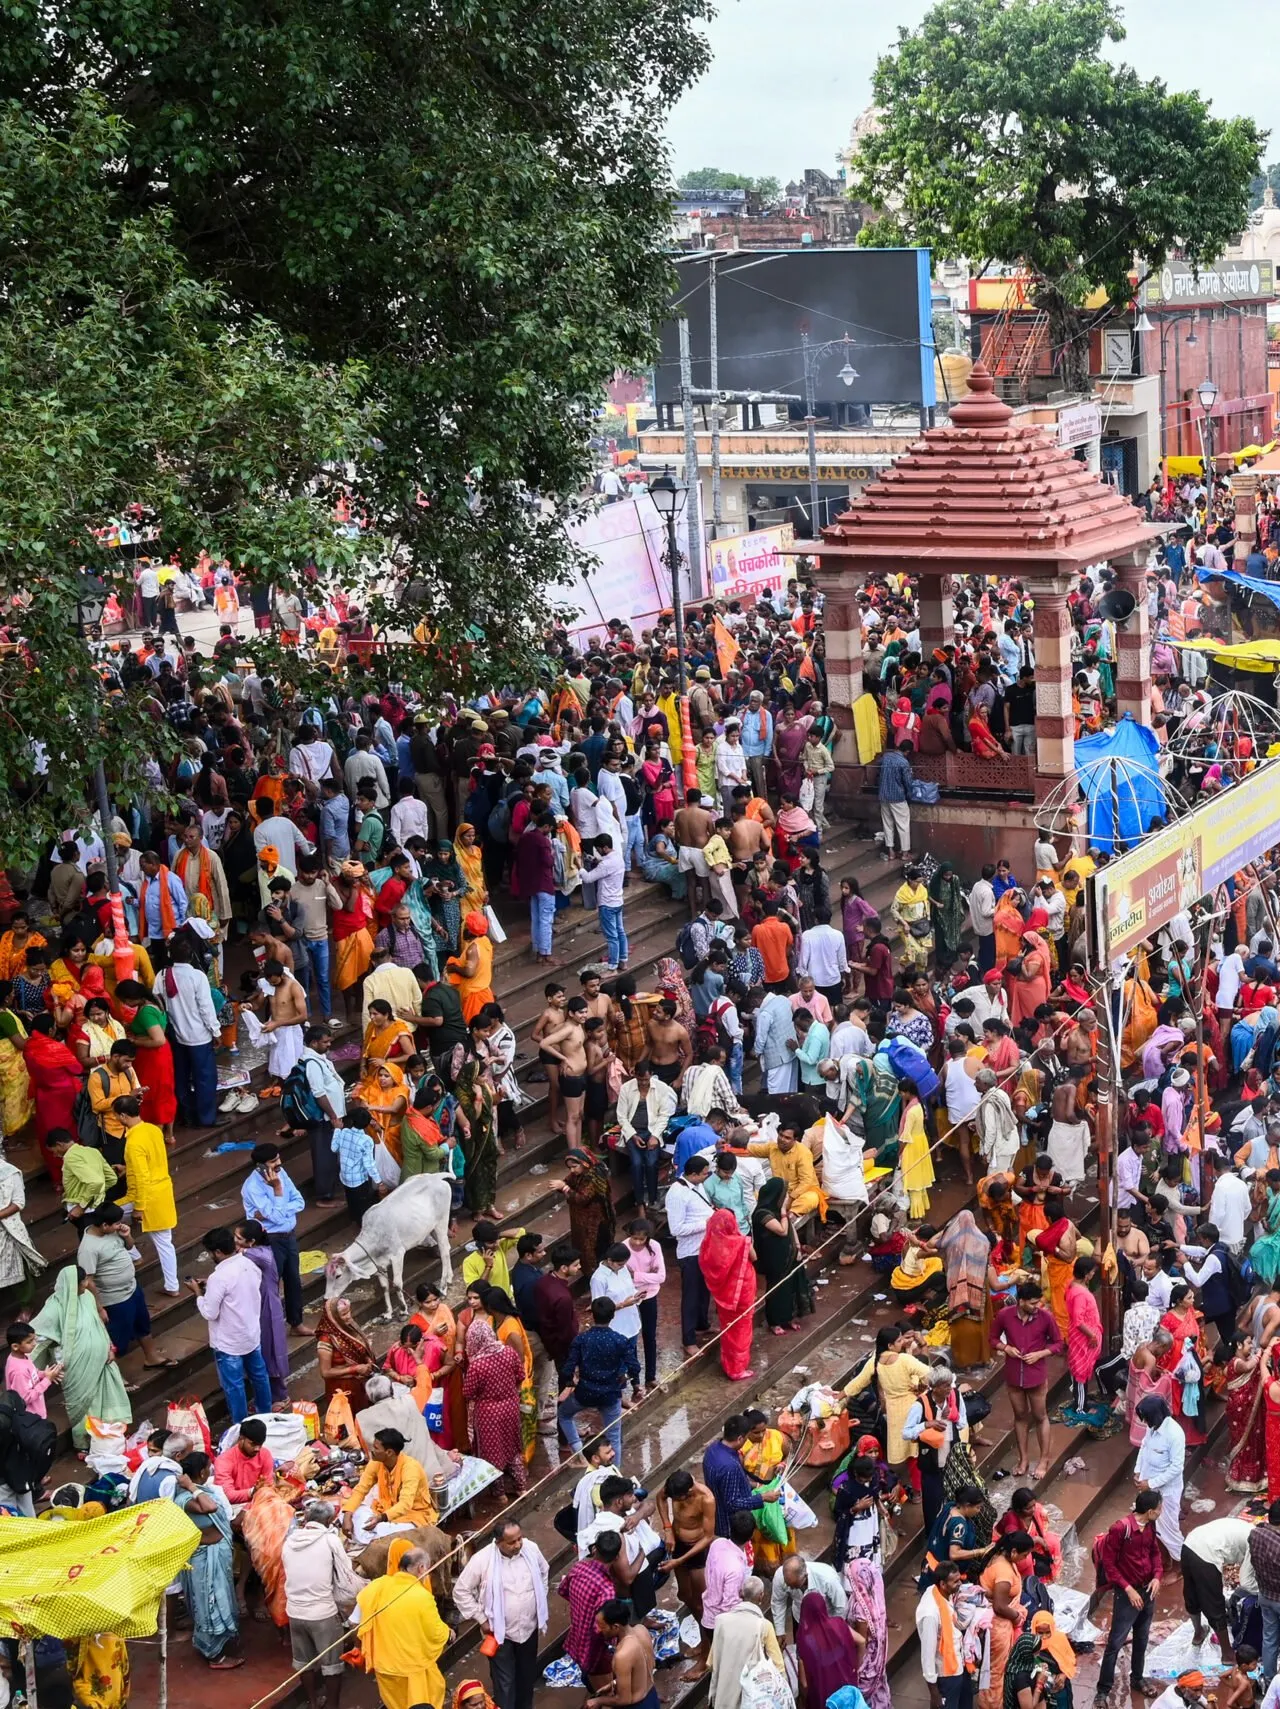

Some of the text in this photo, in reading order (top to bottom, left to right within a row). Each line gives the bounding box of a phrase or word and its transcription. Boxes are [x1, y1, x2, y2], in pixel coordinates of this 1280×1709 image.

[1173, 273, 1194, 296] नगर
[1222, 264, 1250, 294] अयोध्या
[738, 546, 780, 573] पंचकोसी
[1148, 873, 1176, 906] अयोध्या
